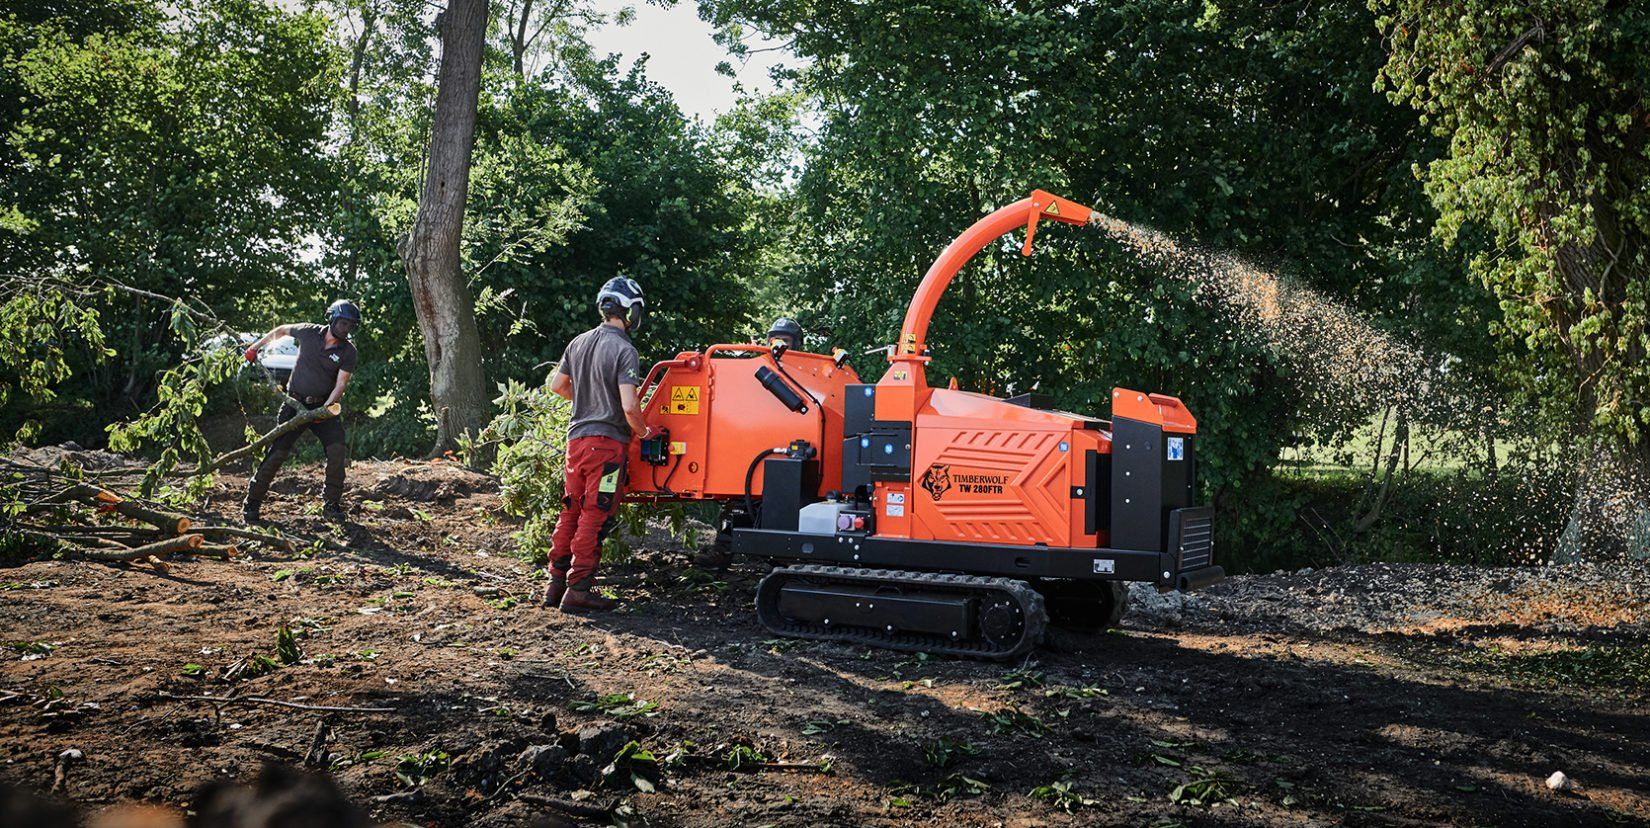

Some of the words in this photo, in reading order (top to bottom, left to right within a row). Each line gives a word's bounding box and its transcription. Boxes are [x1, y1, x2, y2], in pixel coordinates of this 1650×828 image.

[953, 474, 1008, 484] TIMBERWOLF
[959, 484, 971, 492] TW
[973, 485, 1003, 494] 280FTR
